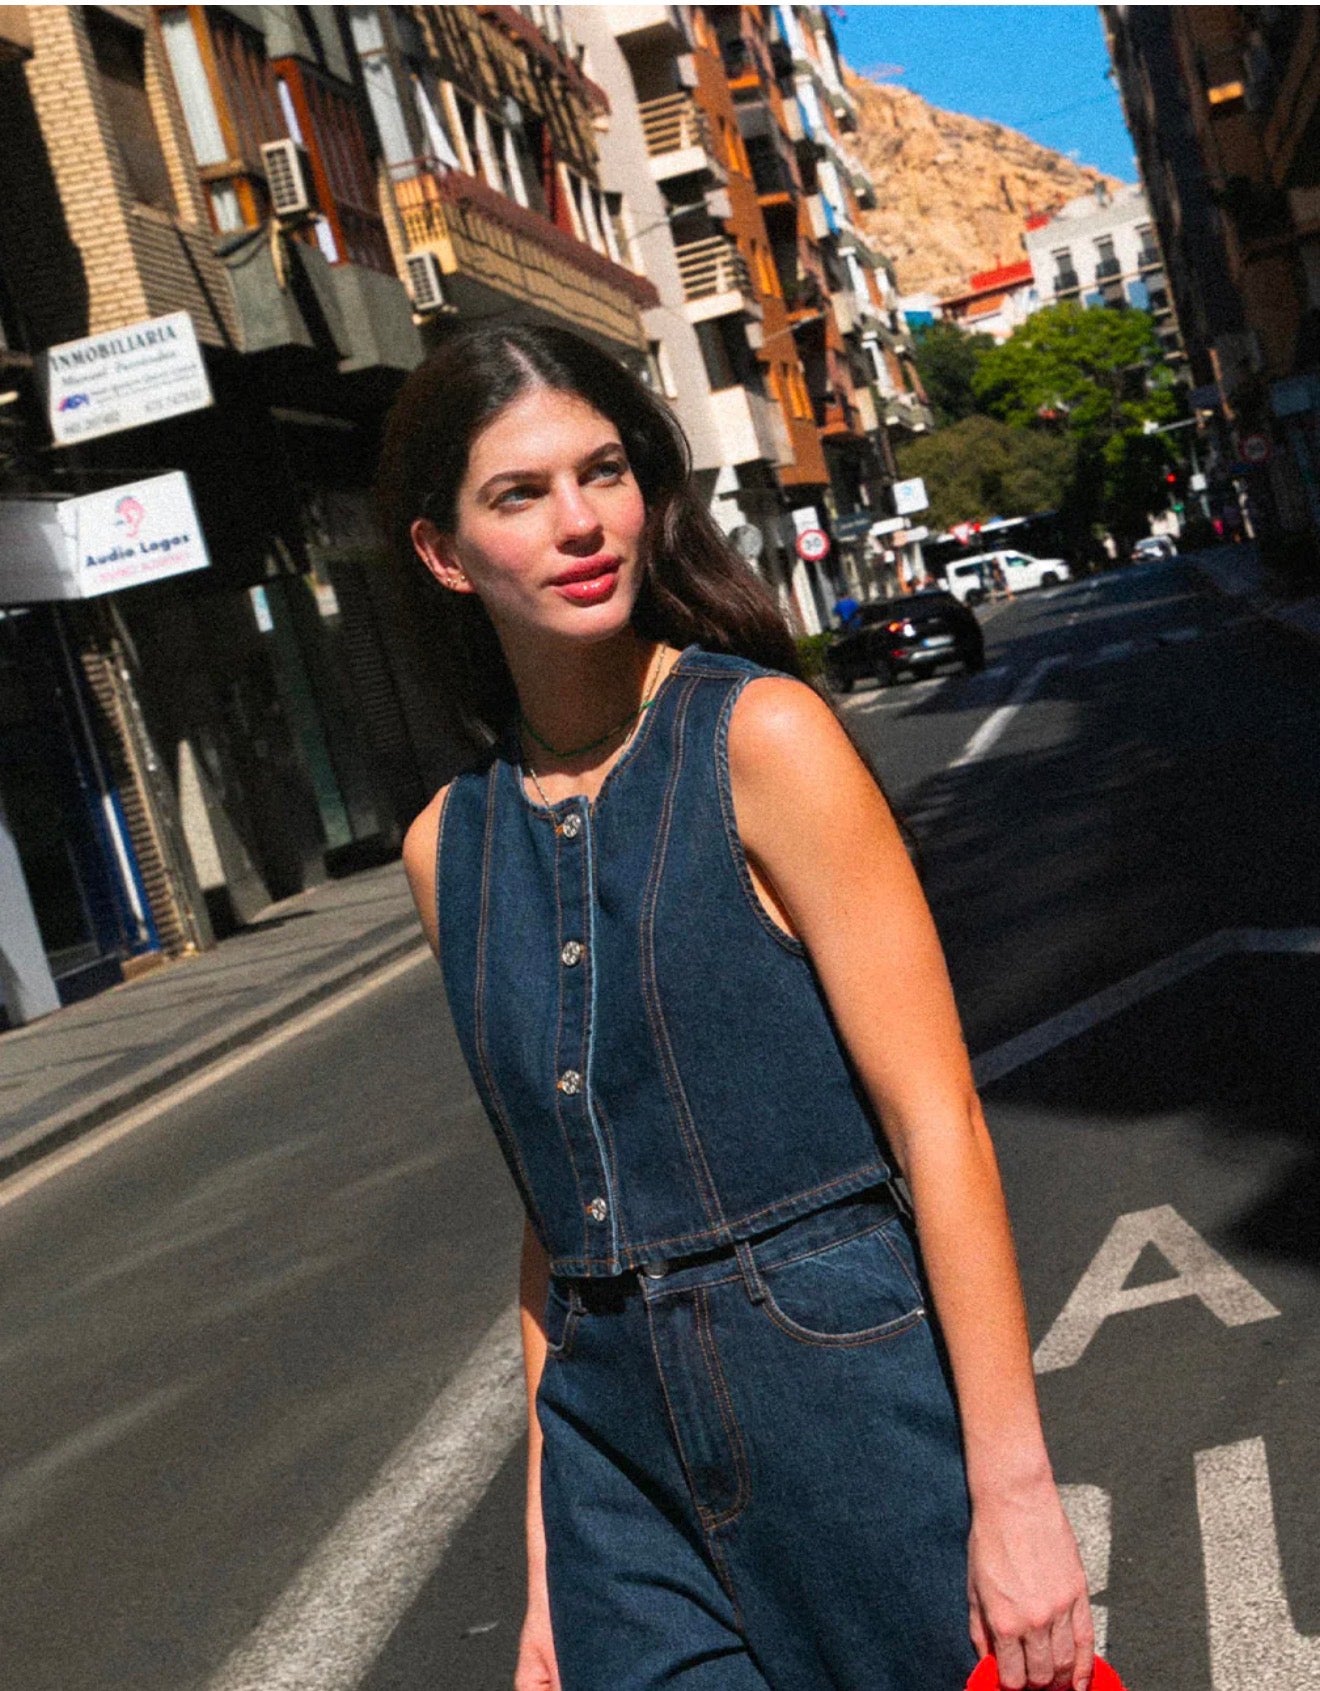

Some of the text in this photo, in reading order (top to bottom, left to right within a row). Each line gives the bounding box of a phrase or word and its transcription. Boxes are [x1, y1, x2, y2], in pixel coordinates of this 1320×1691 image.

[50, 325, 177, 371] INMOBILIARIA
[85, 545, 135, 567] Audio
[139, 533, 190, 553] Logos
